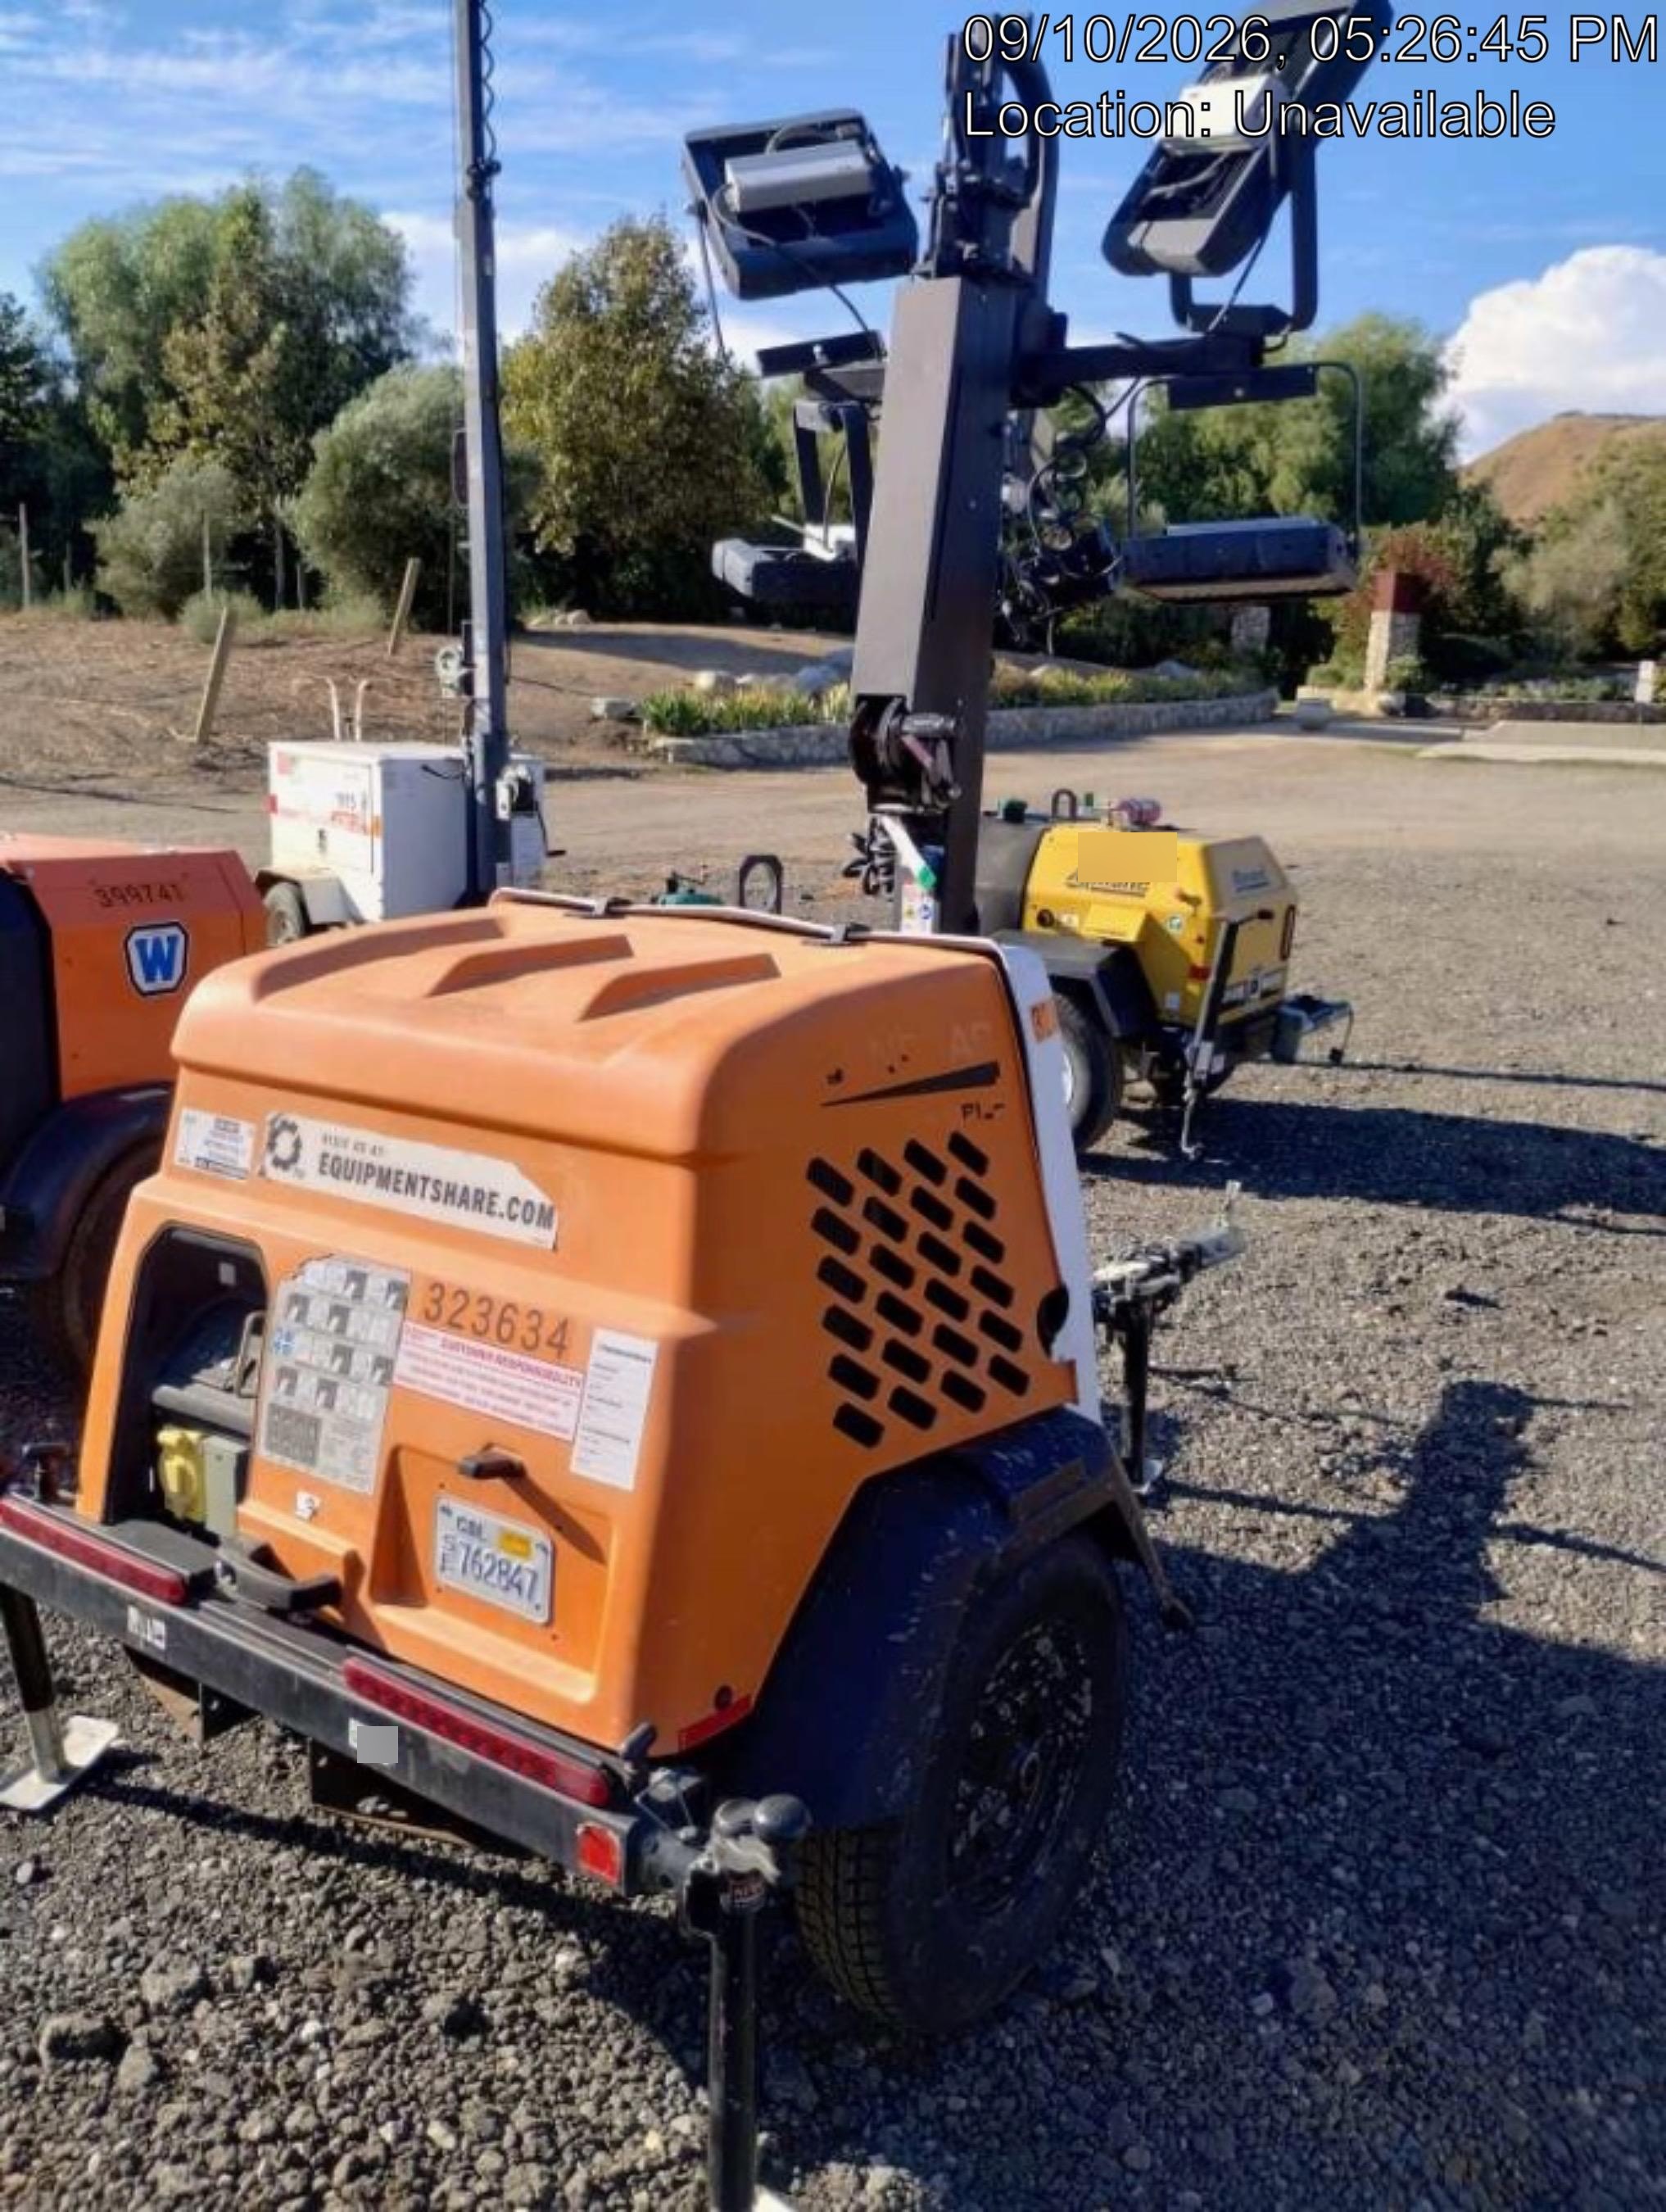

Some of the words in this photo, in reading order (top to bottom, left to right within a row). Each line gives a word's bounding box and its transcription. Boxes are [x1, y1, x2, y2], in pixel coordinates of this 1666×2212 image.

[134, 934, 179, 983] W
[319, 1151, 555, 1230] EQUIPMENTSHARE.COM
[424, 1281, 571, 1360] 323634
